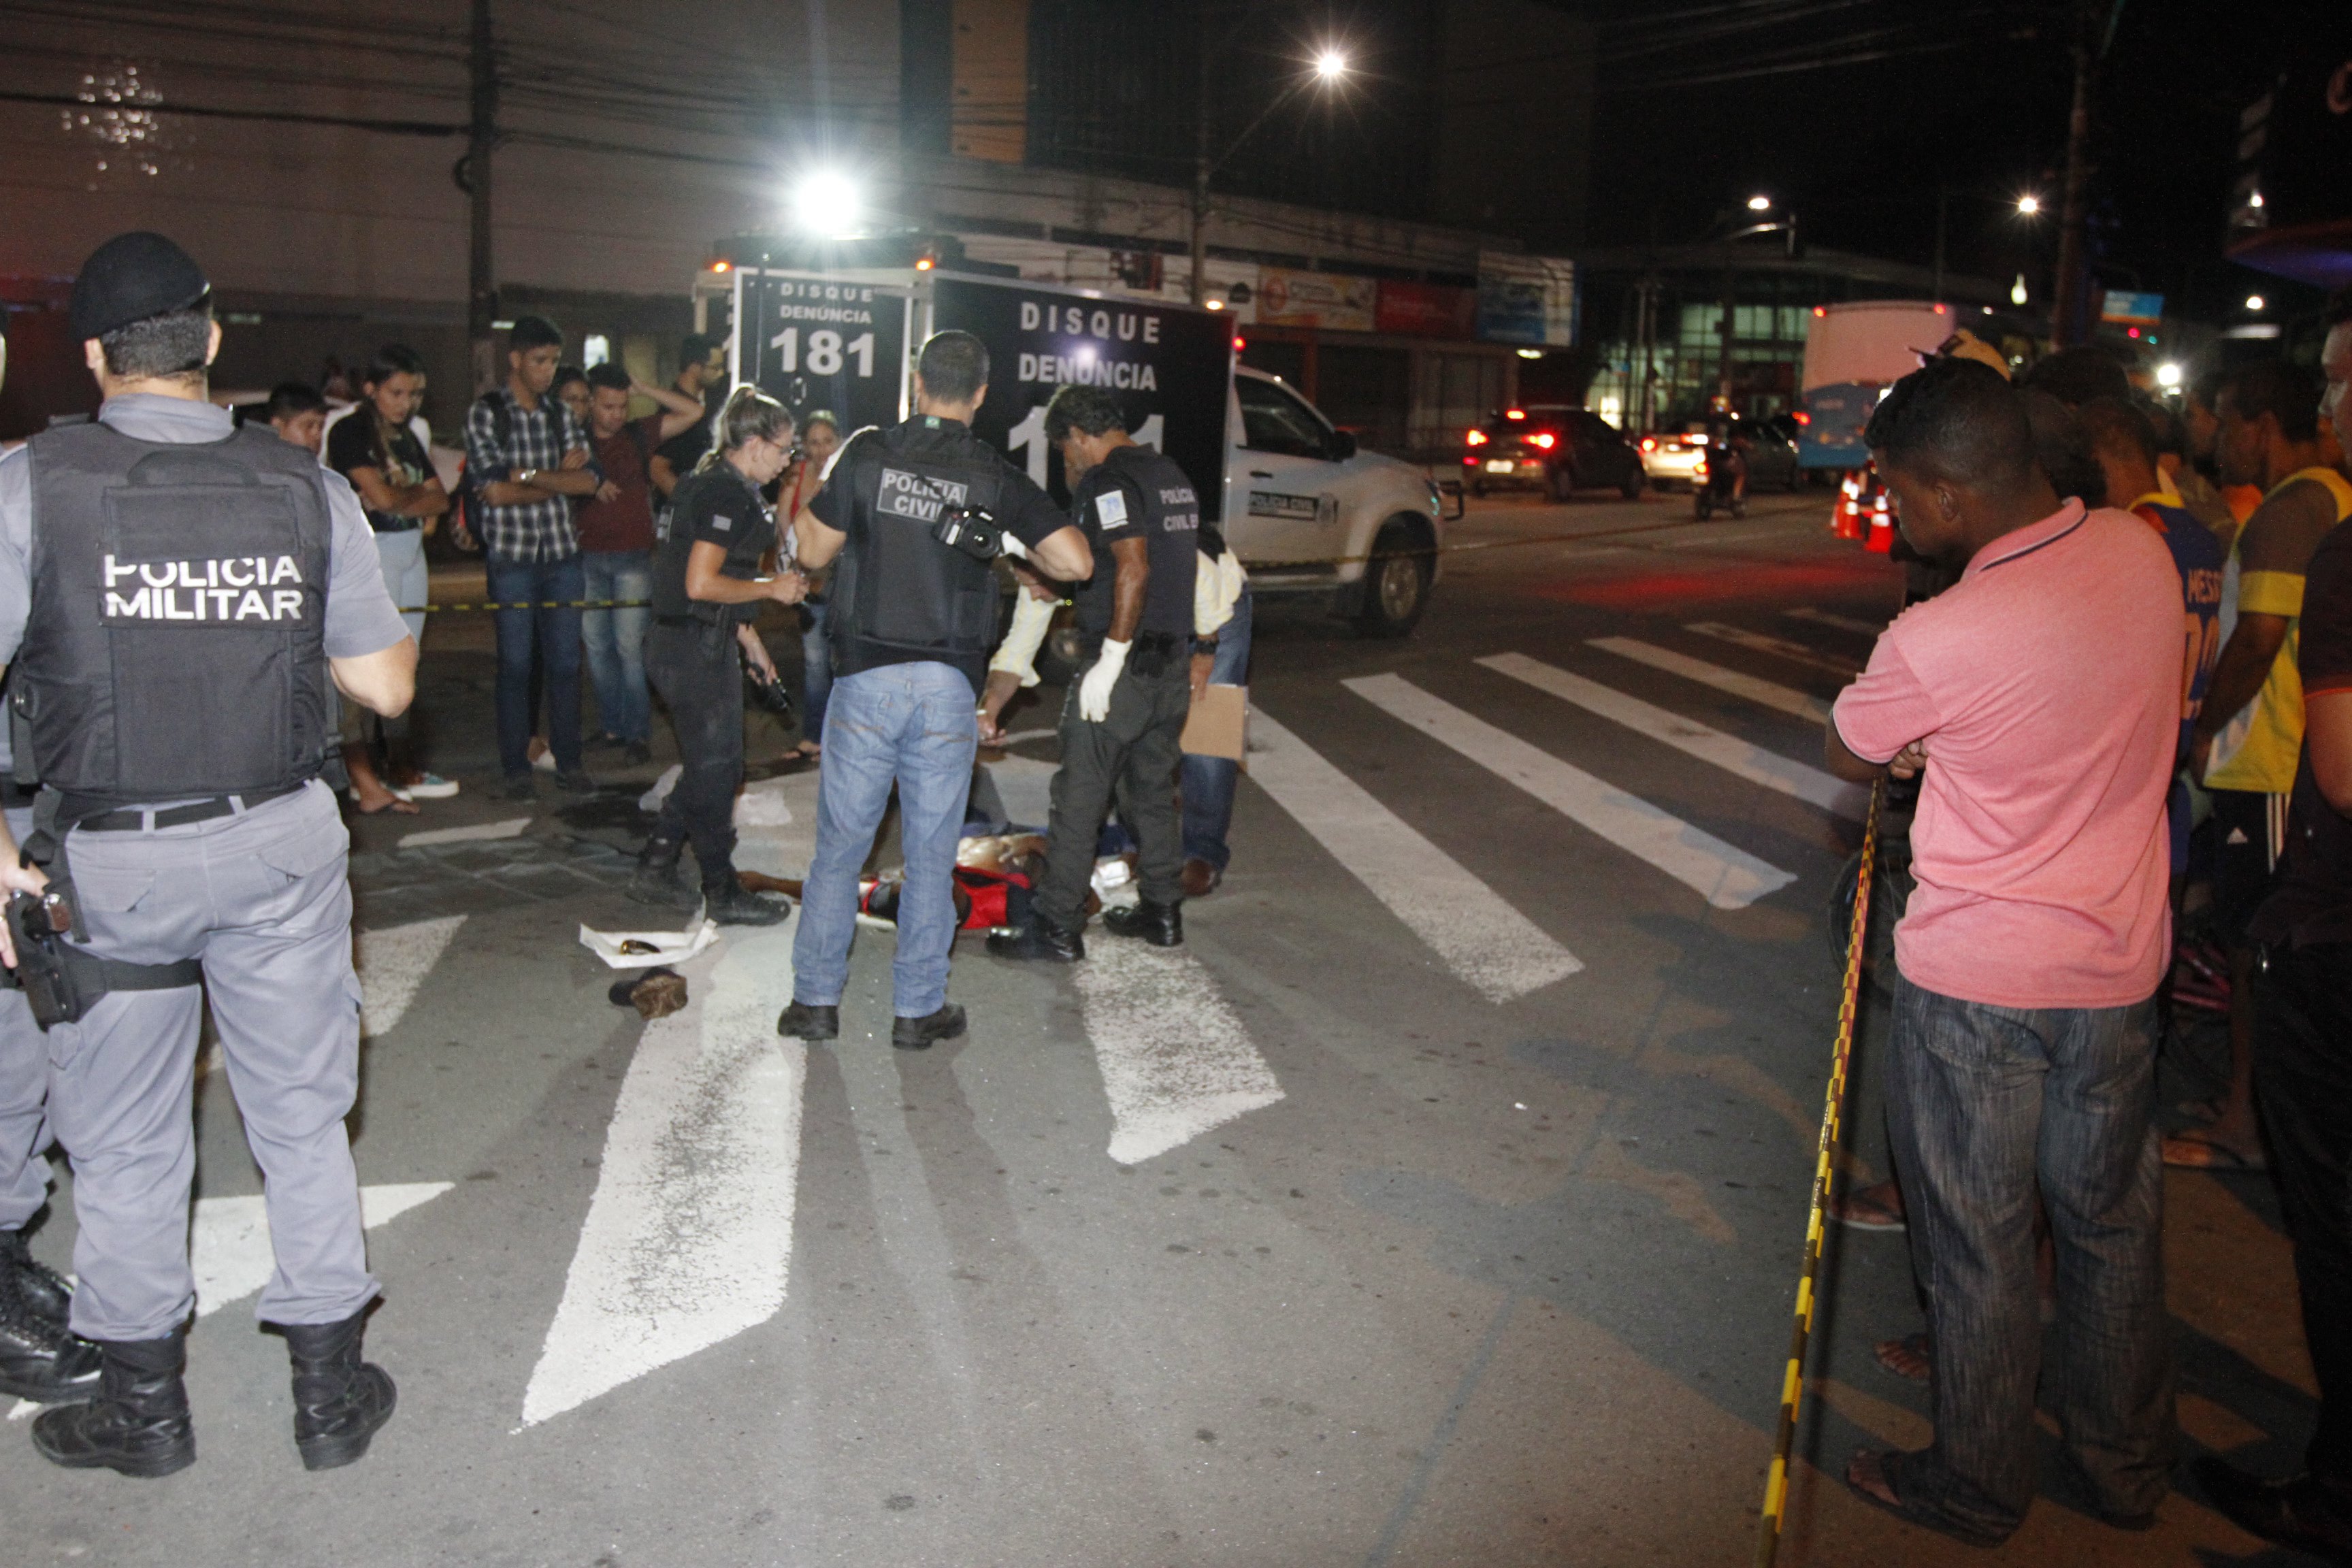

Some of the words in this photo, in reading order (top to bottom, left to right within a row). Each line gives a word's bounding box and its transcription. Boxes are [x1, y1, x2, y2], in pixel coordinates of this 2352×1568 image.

[781, 282, 873, 302] DISQUE
[1021, 301, 1160, 344] DISQUE
[771, 327, 874, 378] 181
[105, 587, 304, 621] MILITAR
